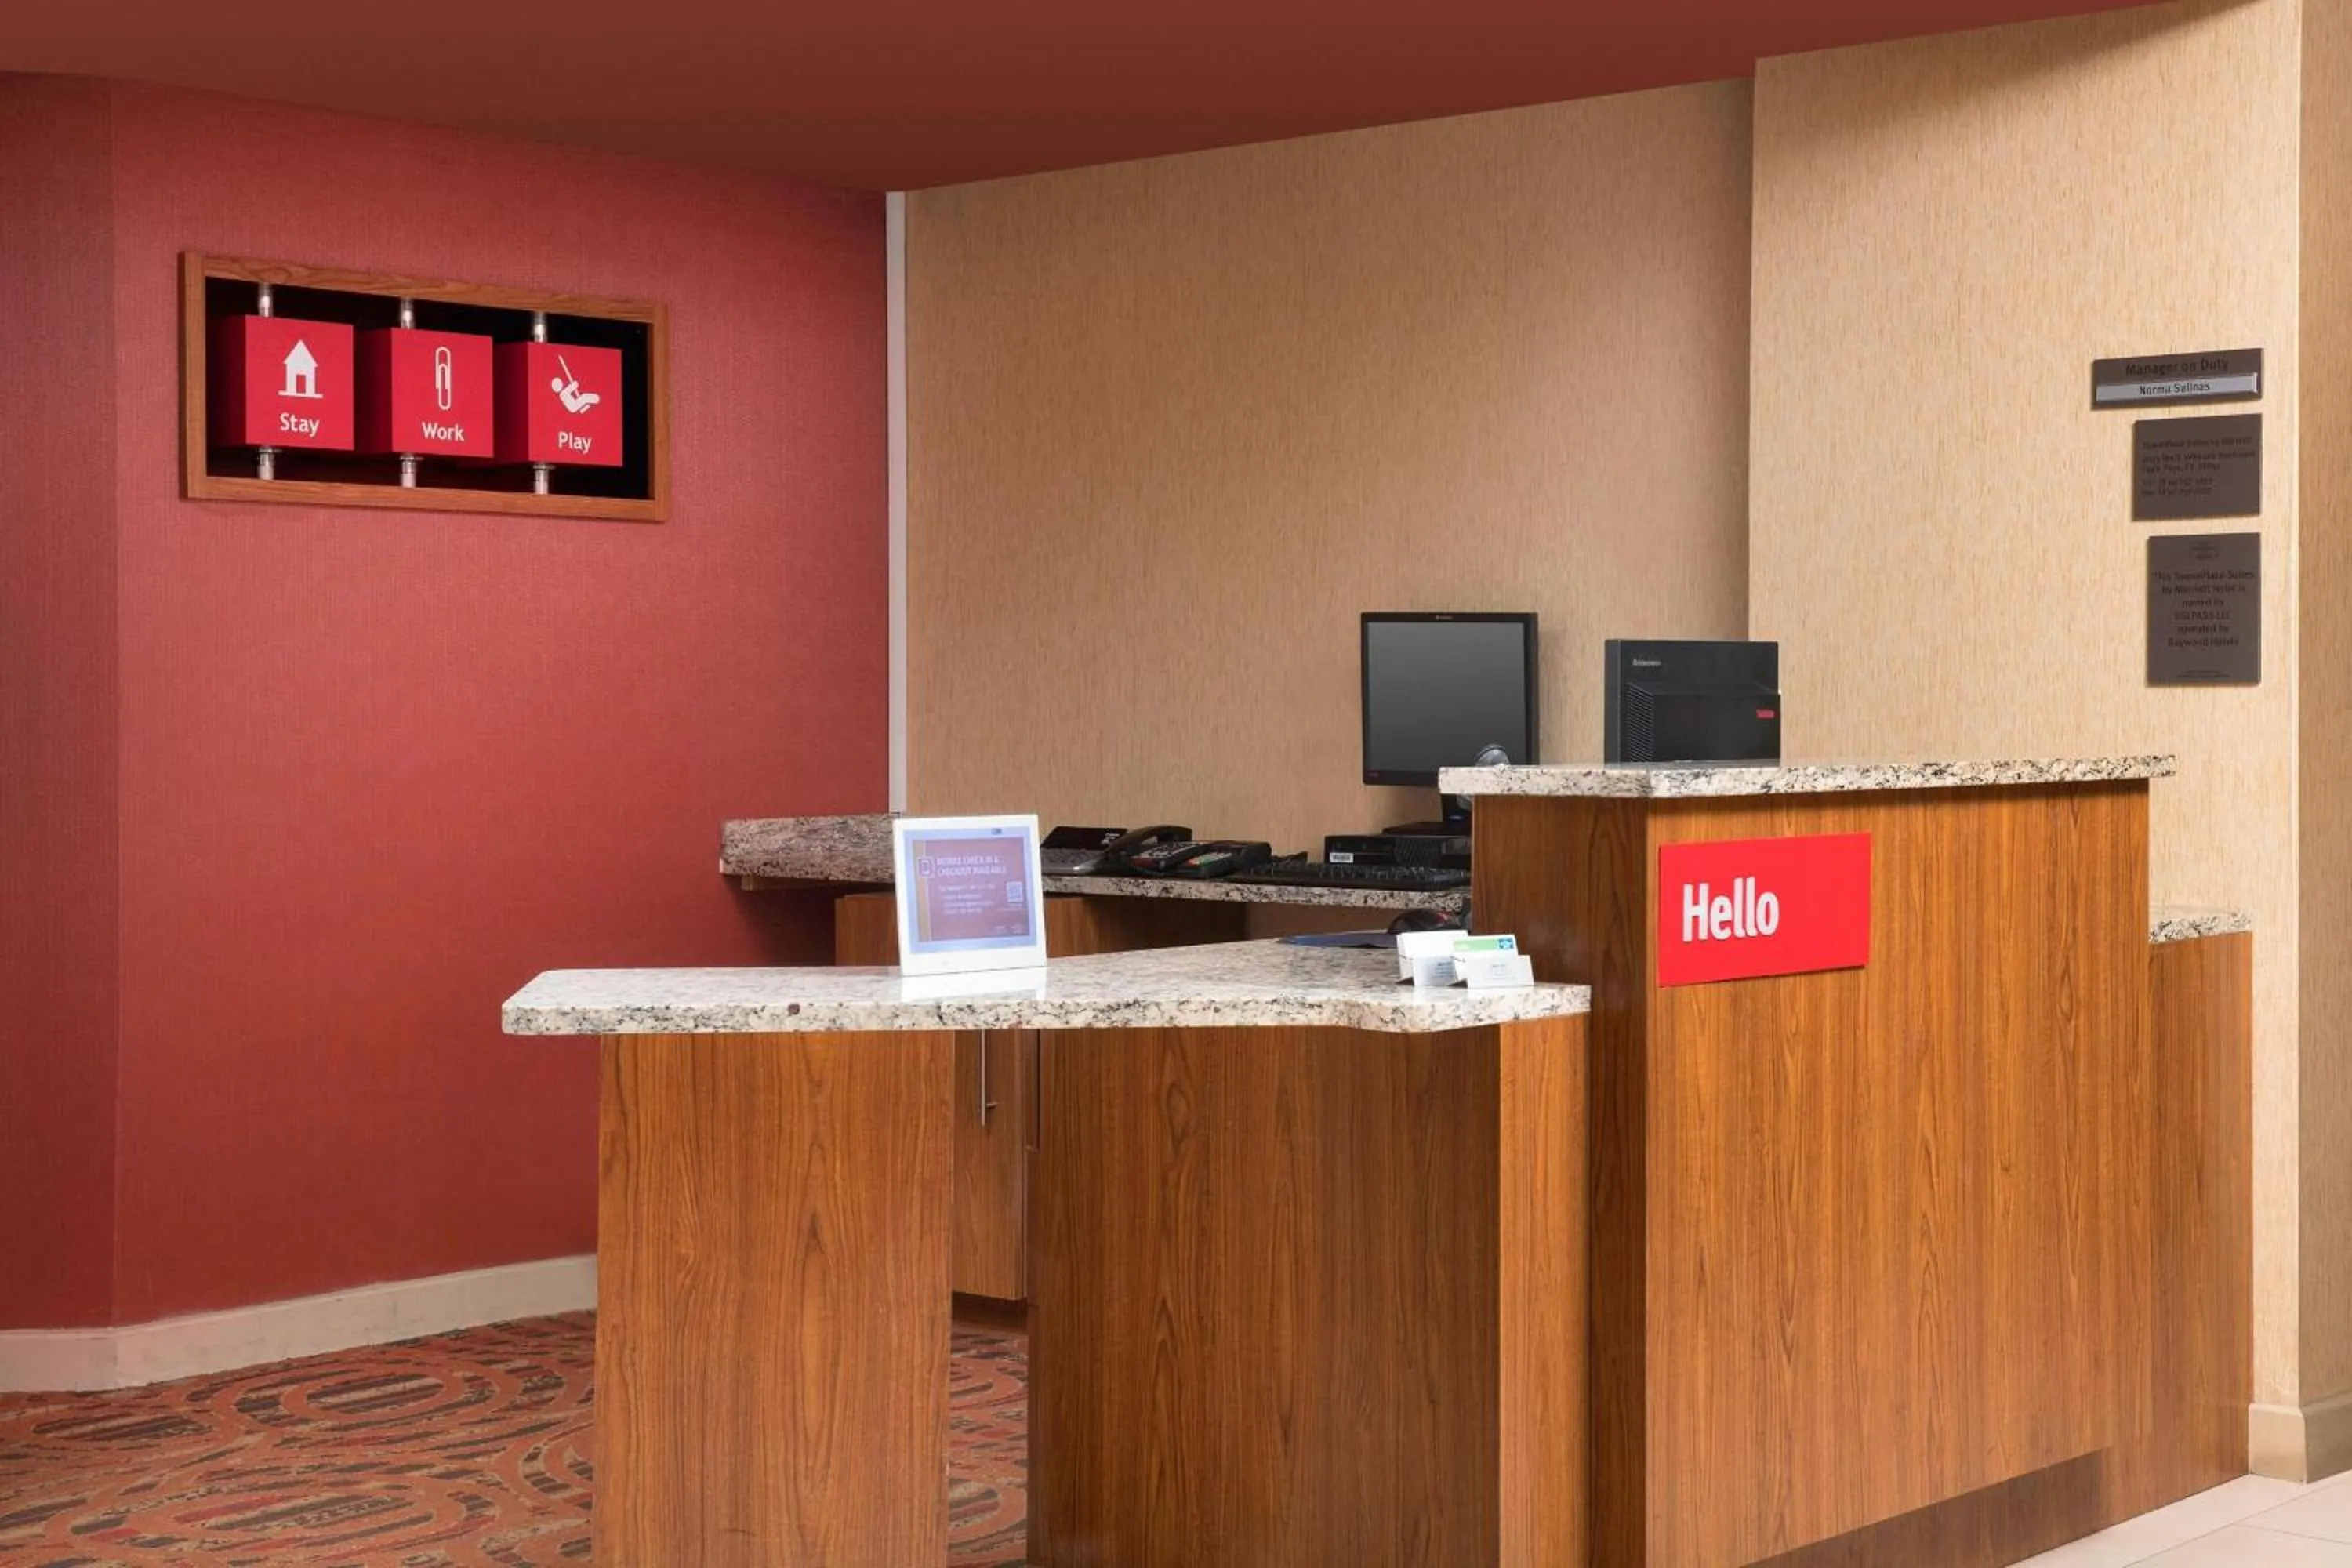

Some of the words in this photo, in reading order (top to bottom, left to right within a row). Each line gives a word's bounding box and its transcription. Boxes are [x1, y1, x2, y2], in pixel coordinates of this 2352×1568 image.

[2125, 362, 2179, 376] Manager
[2182, 361, 2196, 372] on
[2201, 358, 2229, 371] Duty
[279, 412, 320, 438] Stay
[422, 422, 465, 441] Work
[558, 431, 592, 454] Play
[1682, 877, 1780, 942] Hello
